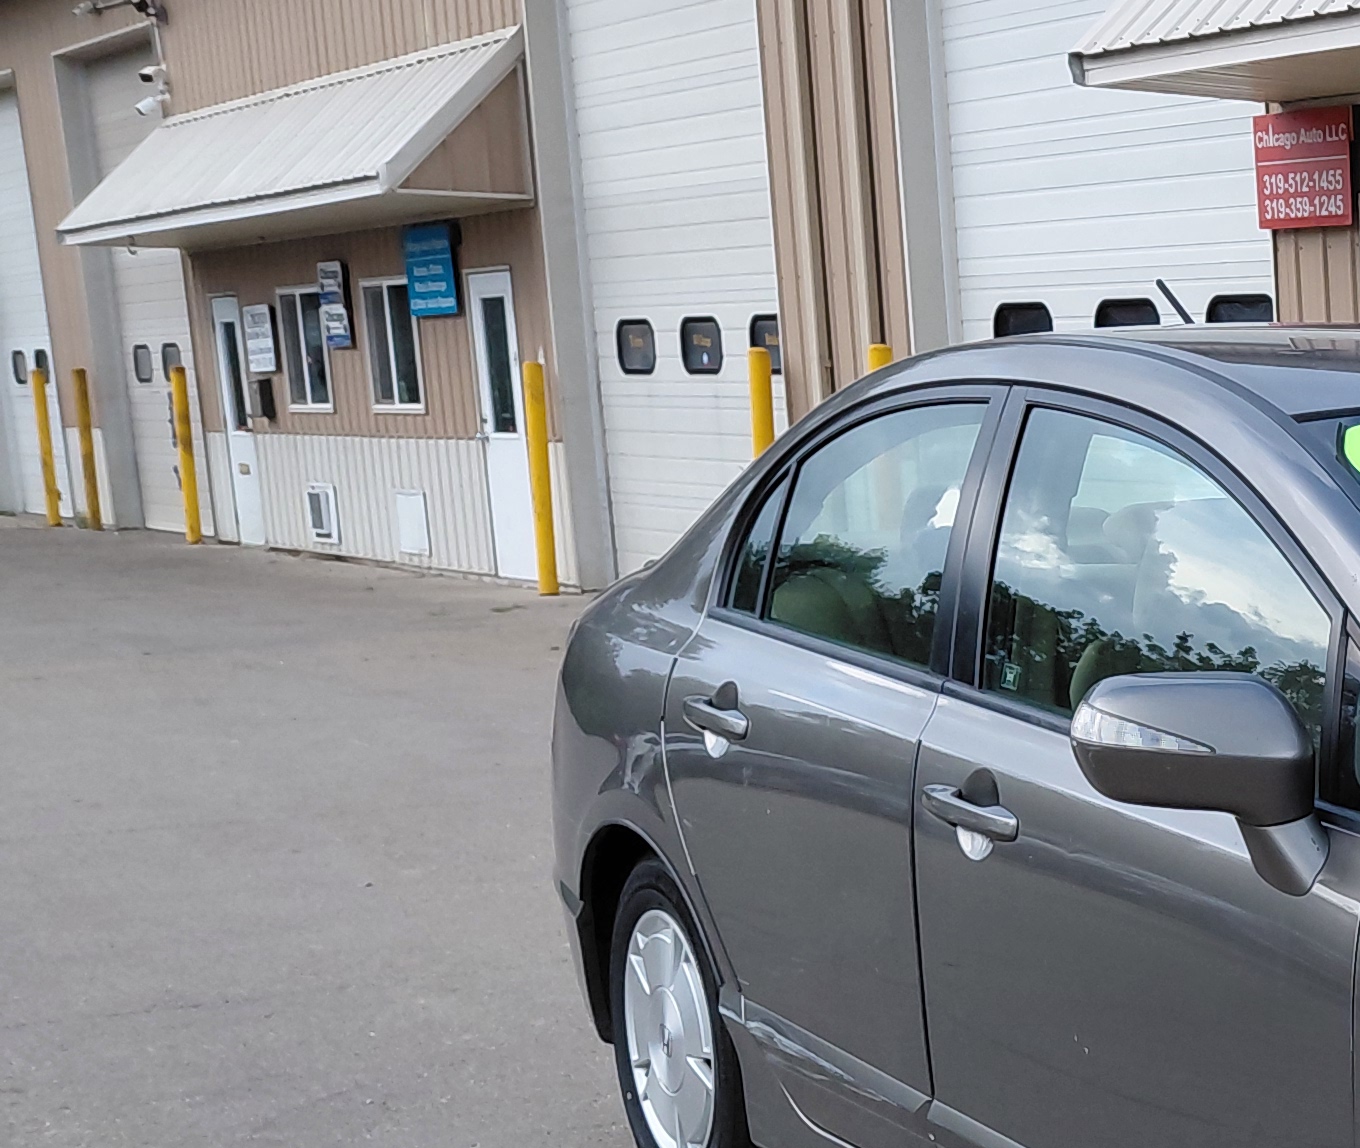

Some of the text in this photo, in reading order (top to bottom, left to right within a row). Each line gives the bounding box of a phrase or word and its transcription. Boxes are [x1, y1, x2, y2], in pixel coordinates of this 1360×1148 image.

[1256, 123, 1347, 149] Chicago Auto LLC
[1263, 169, 1342, 195] 319-512-1455
[1264, 195, 1343, 219] 319-359-1245
